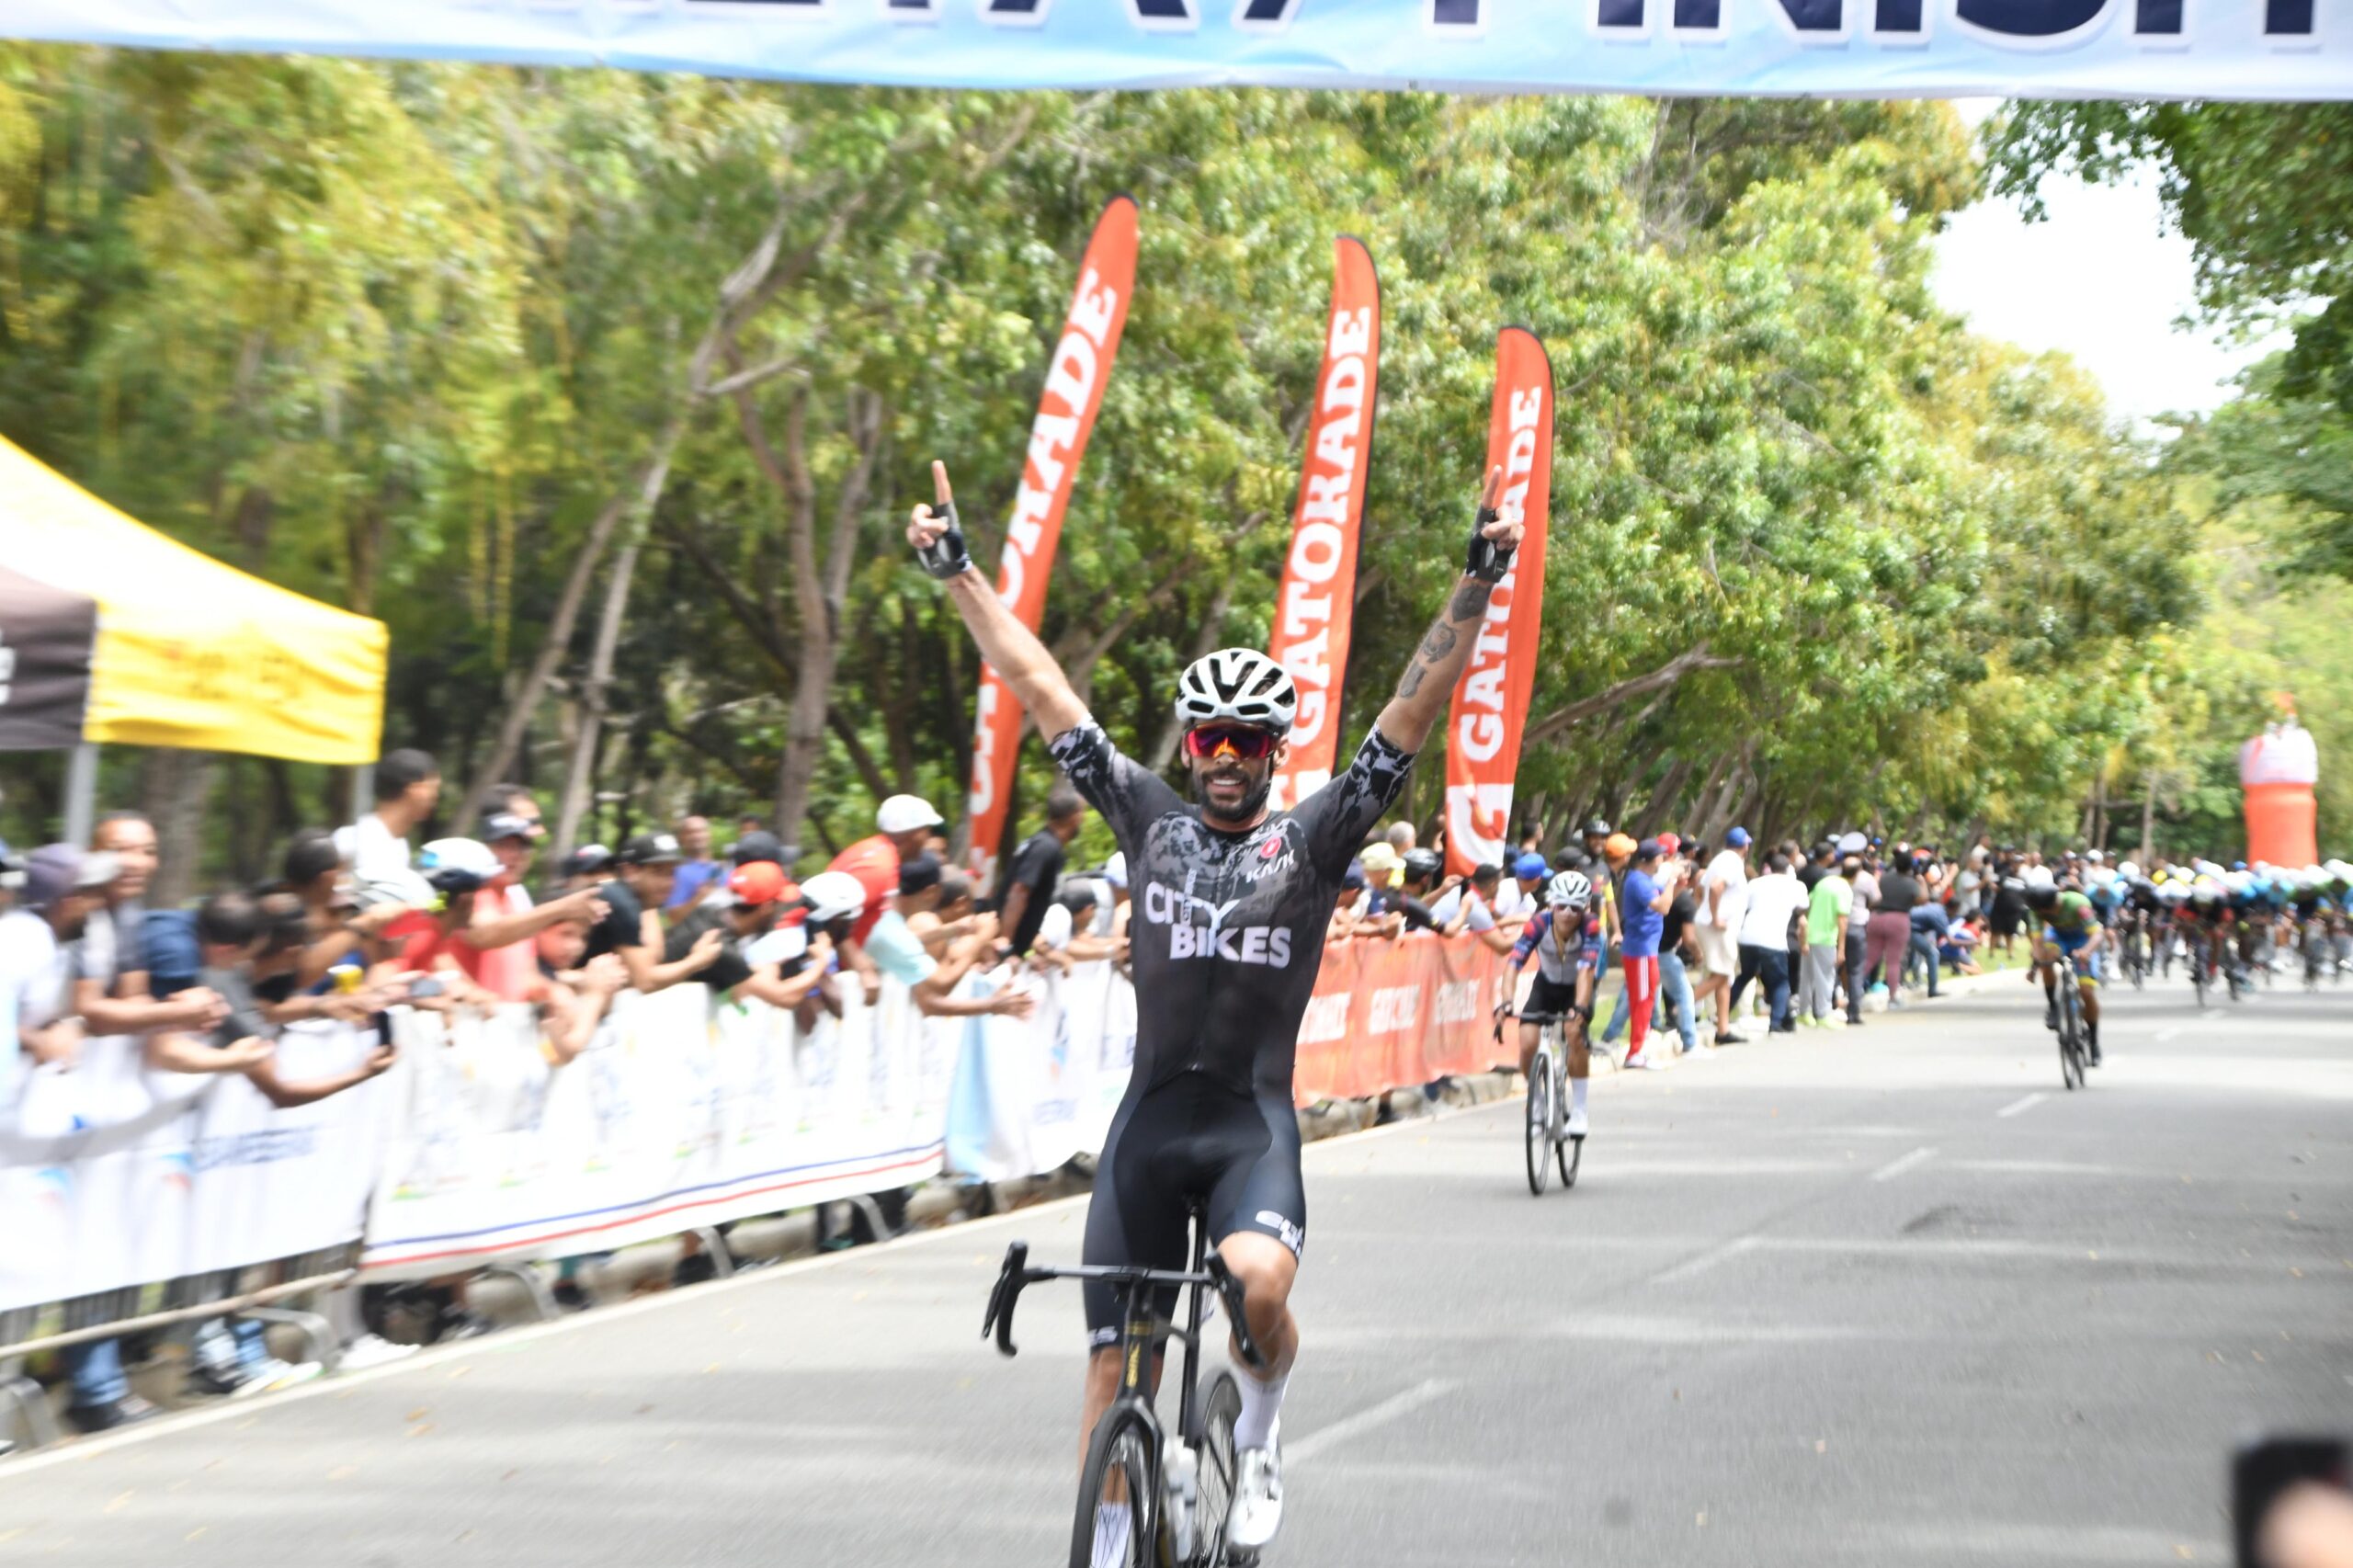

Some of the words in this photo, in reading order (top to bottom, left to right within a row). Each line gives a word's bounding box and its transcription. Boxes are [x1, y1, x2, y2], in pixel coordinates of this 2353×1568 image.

[1282, 305, 1370, 747] GATORADE
[1459, 385, 1542, 764] GATOADE
[1246, 849, 1295, 883] KASK
[1145, 880, 1241, 930] CITY
[1169, 922, 1292, 969] BIKES
